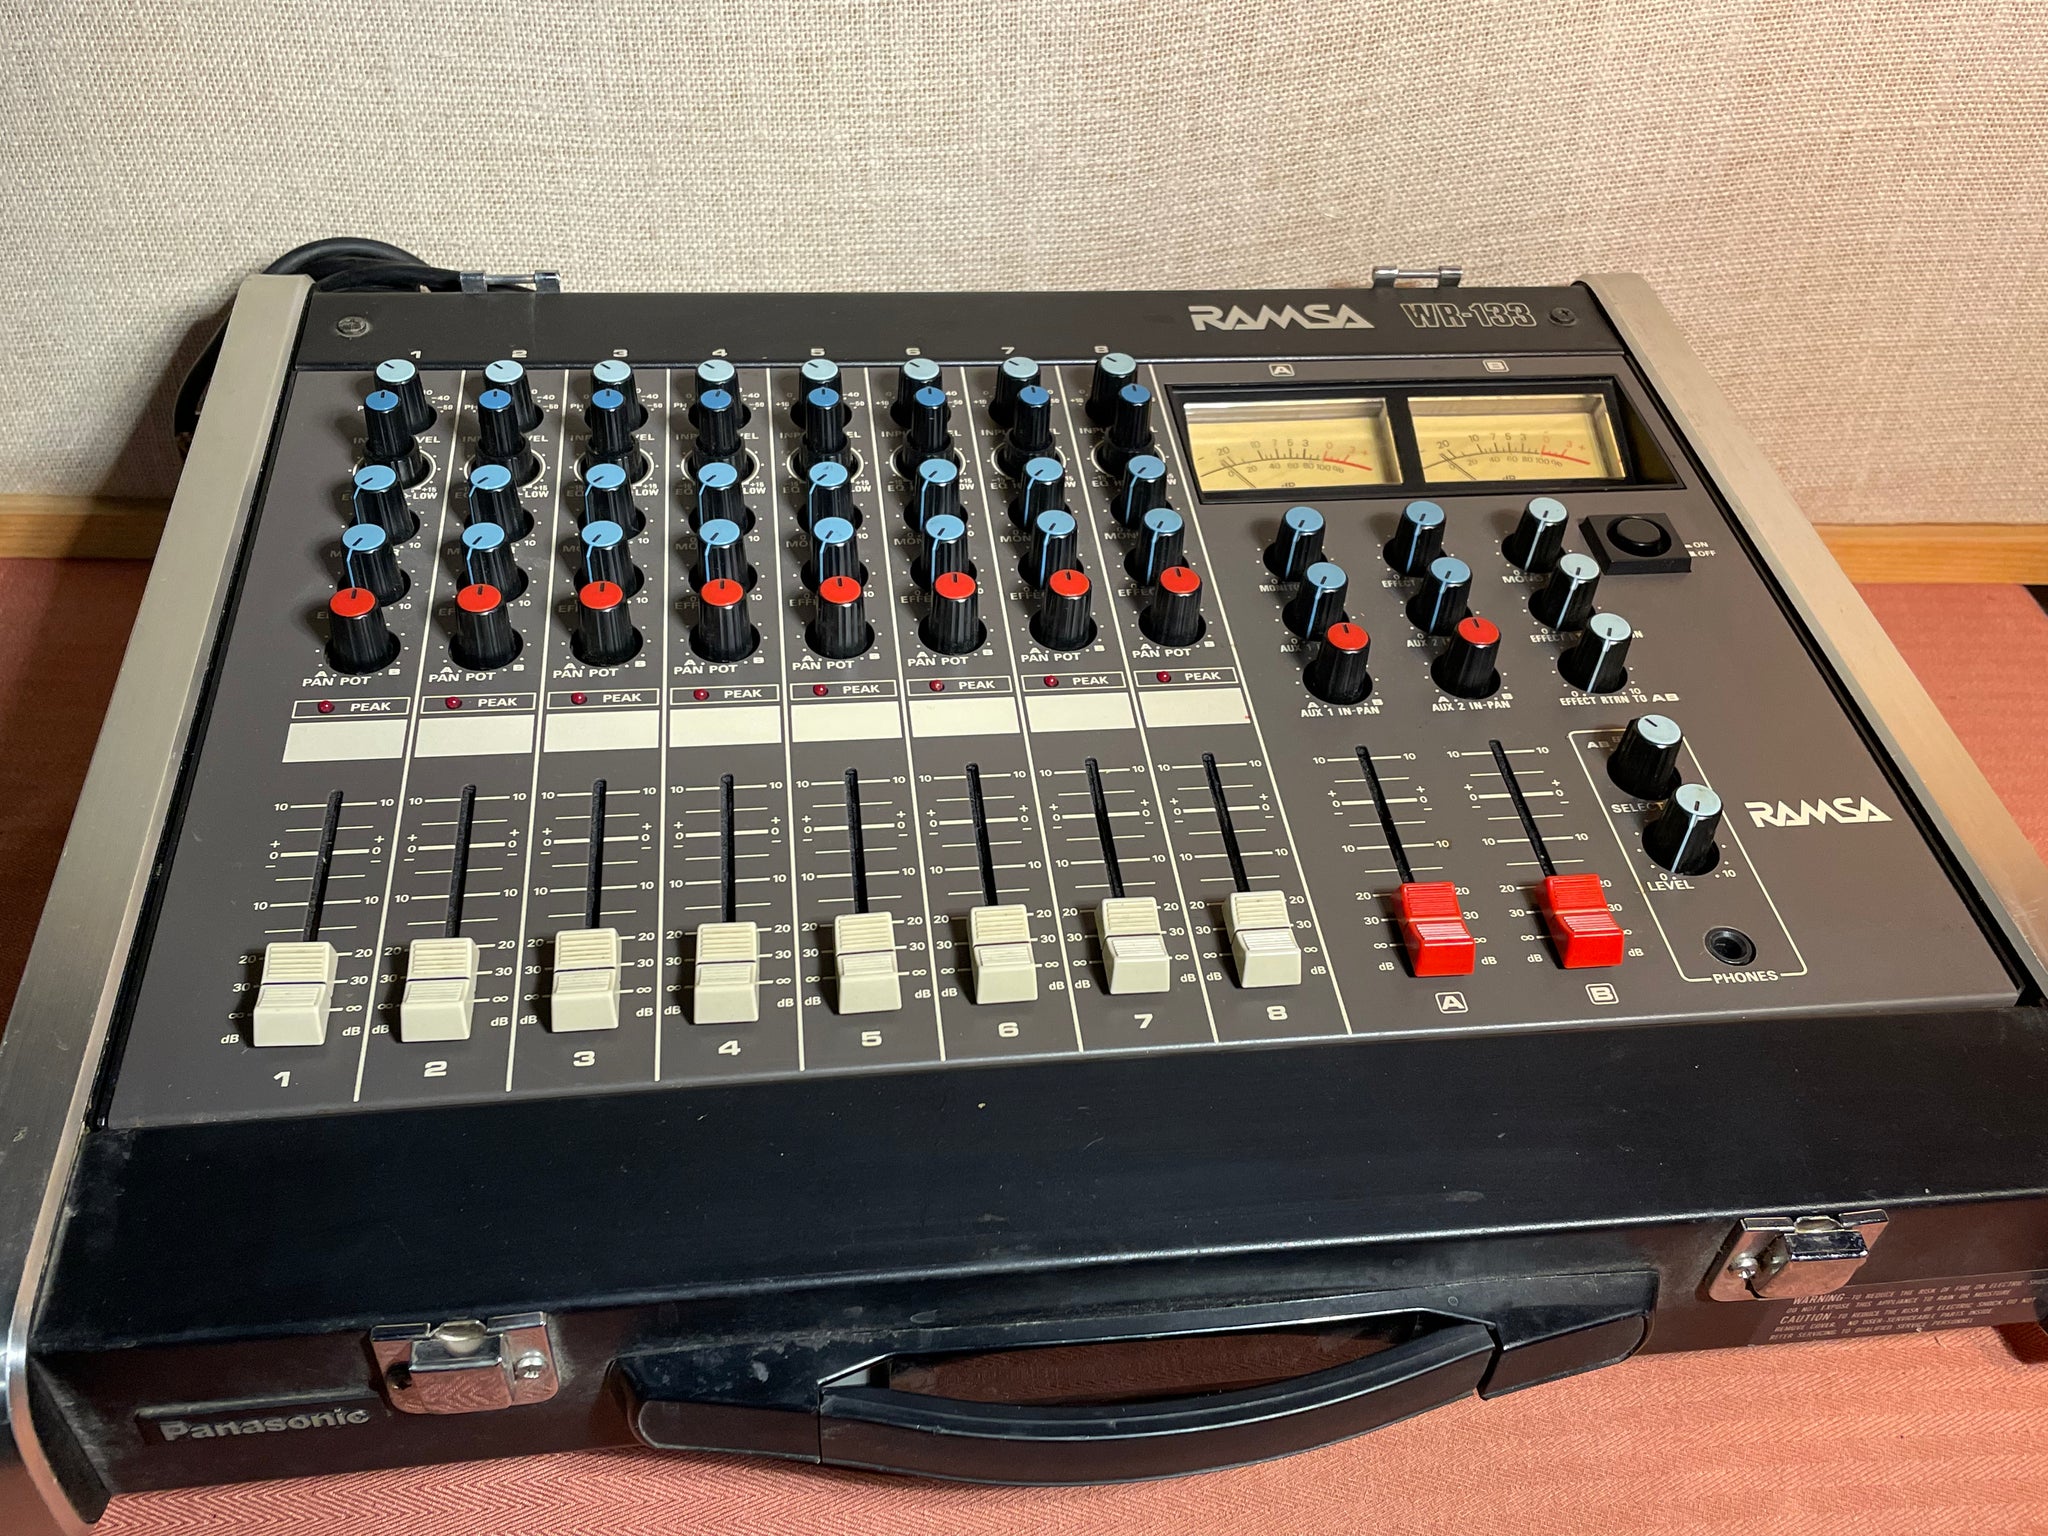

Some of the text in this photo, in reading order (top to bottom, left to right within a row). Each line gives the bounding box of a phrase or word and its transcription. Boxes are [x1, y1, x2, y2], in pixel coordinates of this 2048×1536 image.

[1188, 304, 1375, 330] RAMSA
[1400, 303, 1537, 328] WR-133
[410, 350, 422, 358] 1
[512, 350, 527, 358] 2
[613, 349, 628, 357] 3
[712, 349, 727, 357] 4
[811, 348, 825, 356] 5
[1436, 440, 1449, 449] 20
[1216, 447, 1230, 456] 20
[1536, 457, 1549, 465] 100
[1317, 463, 1331, 471] 100
[412, 490, 437, 499] LOW
[525, 489, 548, 498] LOW
[635, 488, 659, 497] LOW
[1382, 580, 1416, 588] EFFECT
[1530, 634, 1564, 643] EFFECT
[1407, 640, 1428, 648] AUX
[1021, 653, 1081, 662] PAN POT
[1132, 649, 1191, 658] PAN POT
[792, 661, 855, 670] PAN POT
[908, 656, 969, 666] PAN POT
[552, 668, 618, 678] PAN POT
[674, 665, 738, 675] PAN POT
[428, 672, 496, 682] PAN POT
[1072, 676, 1109, 685] PEAK
[1185, 672, 1221, 681] PEAK
[302, 676, 371, 687] PAN POT
[959, 681, 995, 690] PEAK
[724, 690, 762, 698] PEAK
[843, 685, 880, 694] PEAK
[603, 693, 642, 702] PEAK
[1560, 697, 1596, 706] EFFECT
[1600, 696, 1629, 704] RTRN
[1652, 693, 1679, 702] AB
[351, 702, 391, 711] PEAK
[478, 698, 518, 708] PEAK
[1432, 700, 1511, 712] AUX 2 IN-PAN
[1301, 706, 1380, 717] AUX 1 IN-PAN
[1447, 750, 1460, 758] 10
[1313, 756, 1326, 765] 10
[1157, 764, 1170, 772] 10
[1039, 769, 1052, 777] 10
[919, 774, 932, 782] 10
[796, 780, 809, 789] 10
[670, 785, 684, 794] 10
[541, 791, 555, 800] 10
[408, 797, 422, 806] 10
[274, 802, 288, 811] 10
[1611, 802, 1664, 814] SELECT
[1744, 796, 1893, 827] RAMSA
[1575, 832, 1588, 841] 10
[1436, 839, 1450, 849] 10
[1659, 873, 1668, 881] 0
[1722, 869, 1737, 879] 10
[1499, 884, 1514, 894] 20
[1647, 880, 1694, 892] LEVEL
[1356, 891, 1371, 901] 20
[1296, 920, 1311, 929] 30
[1169, 927, 1184, 936] 30
[1040, 934, 1056, 943] 30
[909, 942, 925, 951] 30
[775, 949, 791, 959] 30
[1527, 953, 1543, 963] dB
[637, 958, 654, 967] 30
[1379, 961, 1394, 971] dB
[495, 966, 513, 976] 30
[1310, 966, 1326, 975] dB
[350, 975, 368, 985] 30
[1180, 973, 1196, 983] dB
[1712, 970, 1779, 984] PHONES
[1049, 981, 1065, 991] dB
[915, 989, 931, 999] dB
[777, 998, 794, 1007] dB
[636, 1007, 654, 1017] dB
[1267, 1005, 1288, 1020] 8
[490, 1016, 509, 1027] dB
[1134, 1014, 1153, 1028] 7
[342, 1026, 361, 1036] dB
[998, 1022, 1019, 1037] 6
[861, 1031, 882, 1047] 5
[718, 1040, 741, 1056] 4
[573, 1050, 596, 1066] 3
[424, 1060, 447, 1077] 2
[273, 1071, 291, 1087] 1
[1793, 1293, 1845, 1304] WARNING
[1780, 1313, 1831, 1324] CAUTION
[159, 1406, 371, 1441] Panasonic
